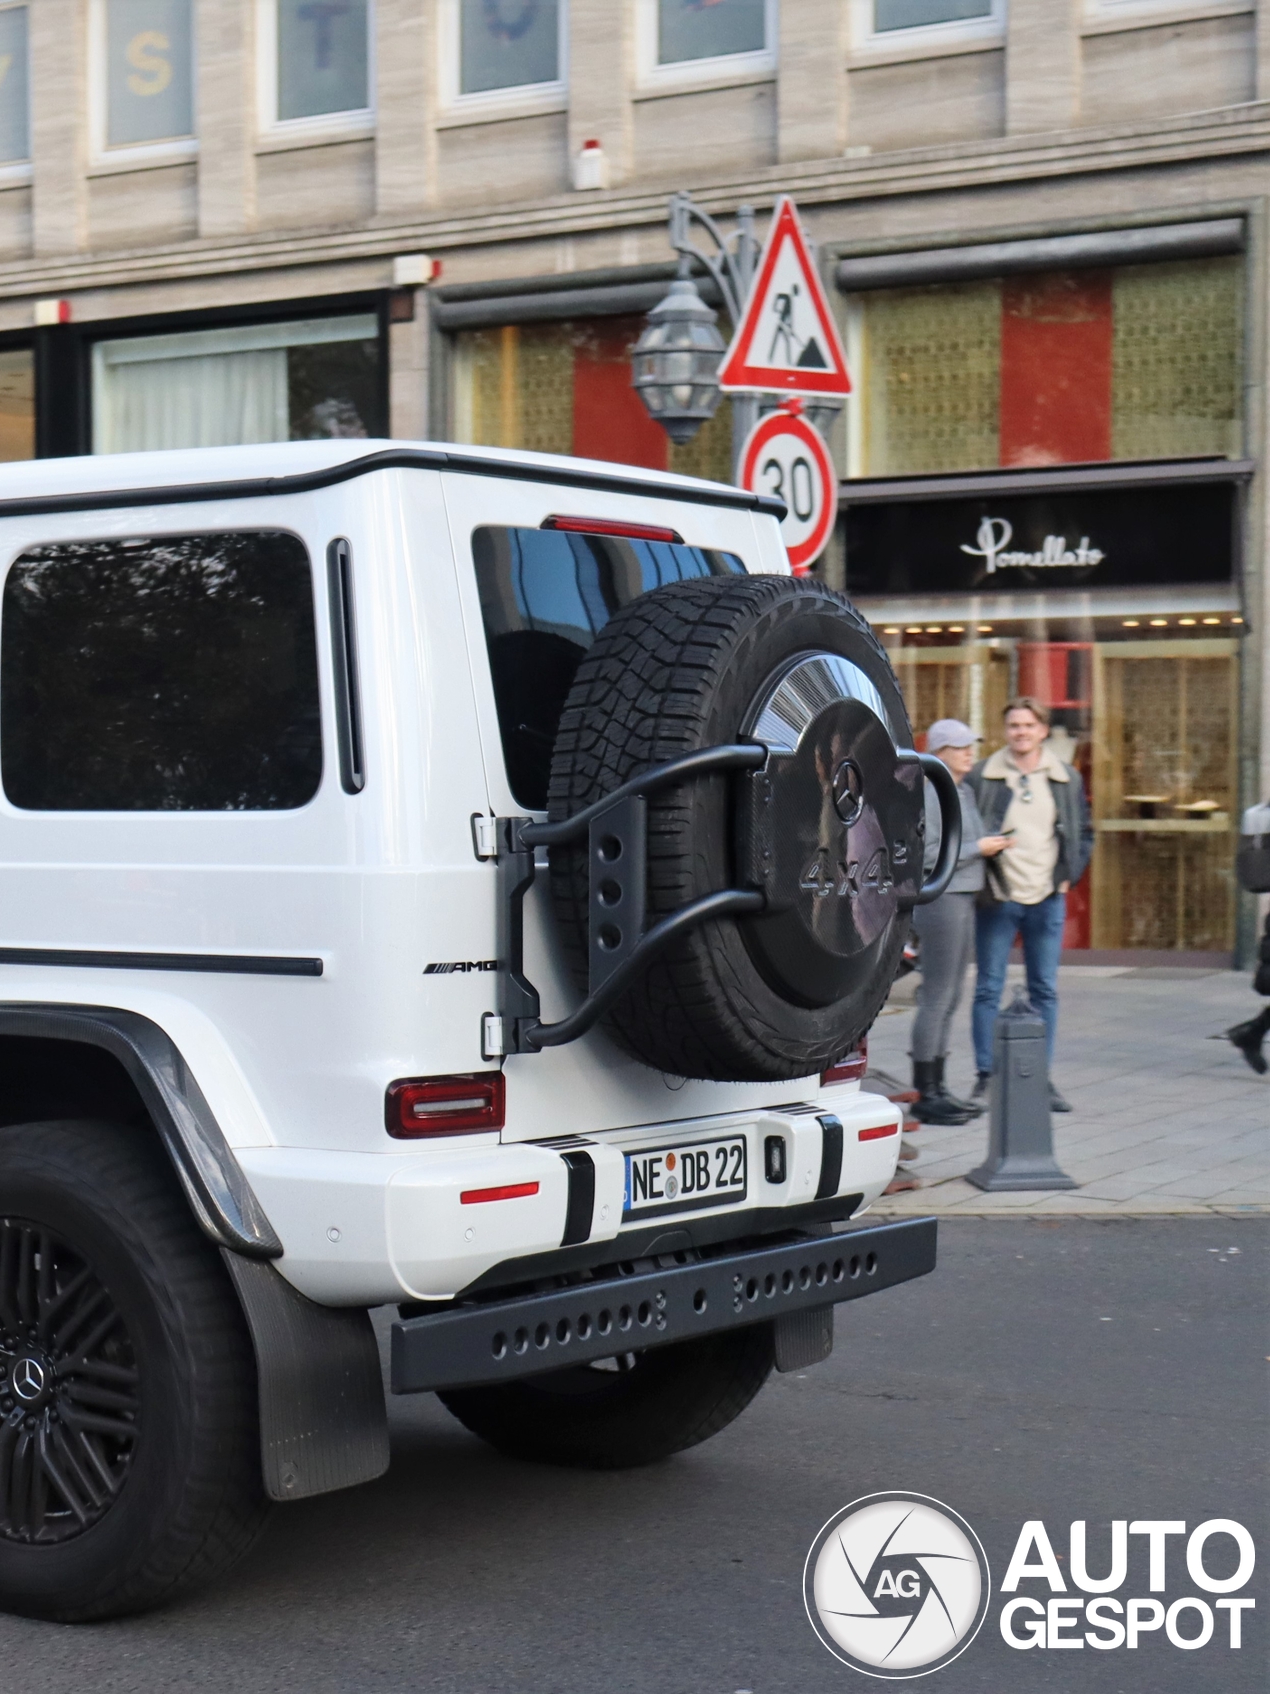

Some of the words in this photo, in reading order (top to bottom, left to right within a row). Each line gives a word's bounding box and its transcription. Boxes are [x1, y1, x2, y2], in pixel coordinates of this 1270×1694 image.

[762, 456, 814, 523] 30
[959, 516, 1106, 574] Pomellato
[633, 1157, 665, 1203] NE
[680, 1150, 711, 1194] DB
[714, 1144, 744, 1189] 22
